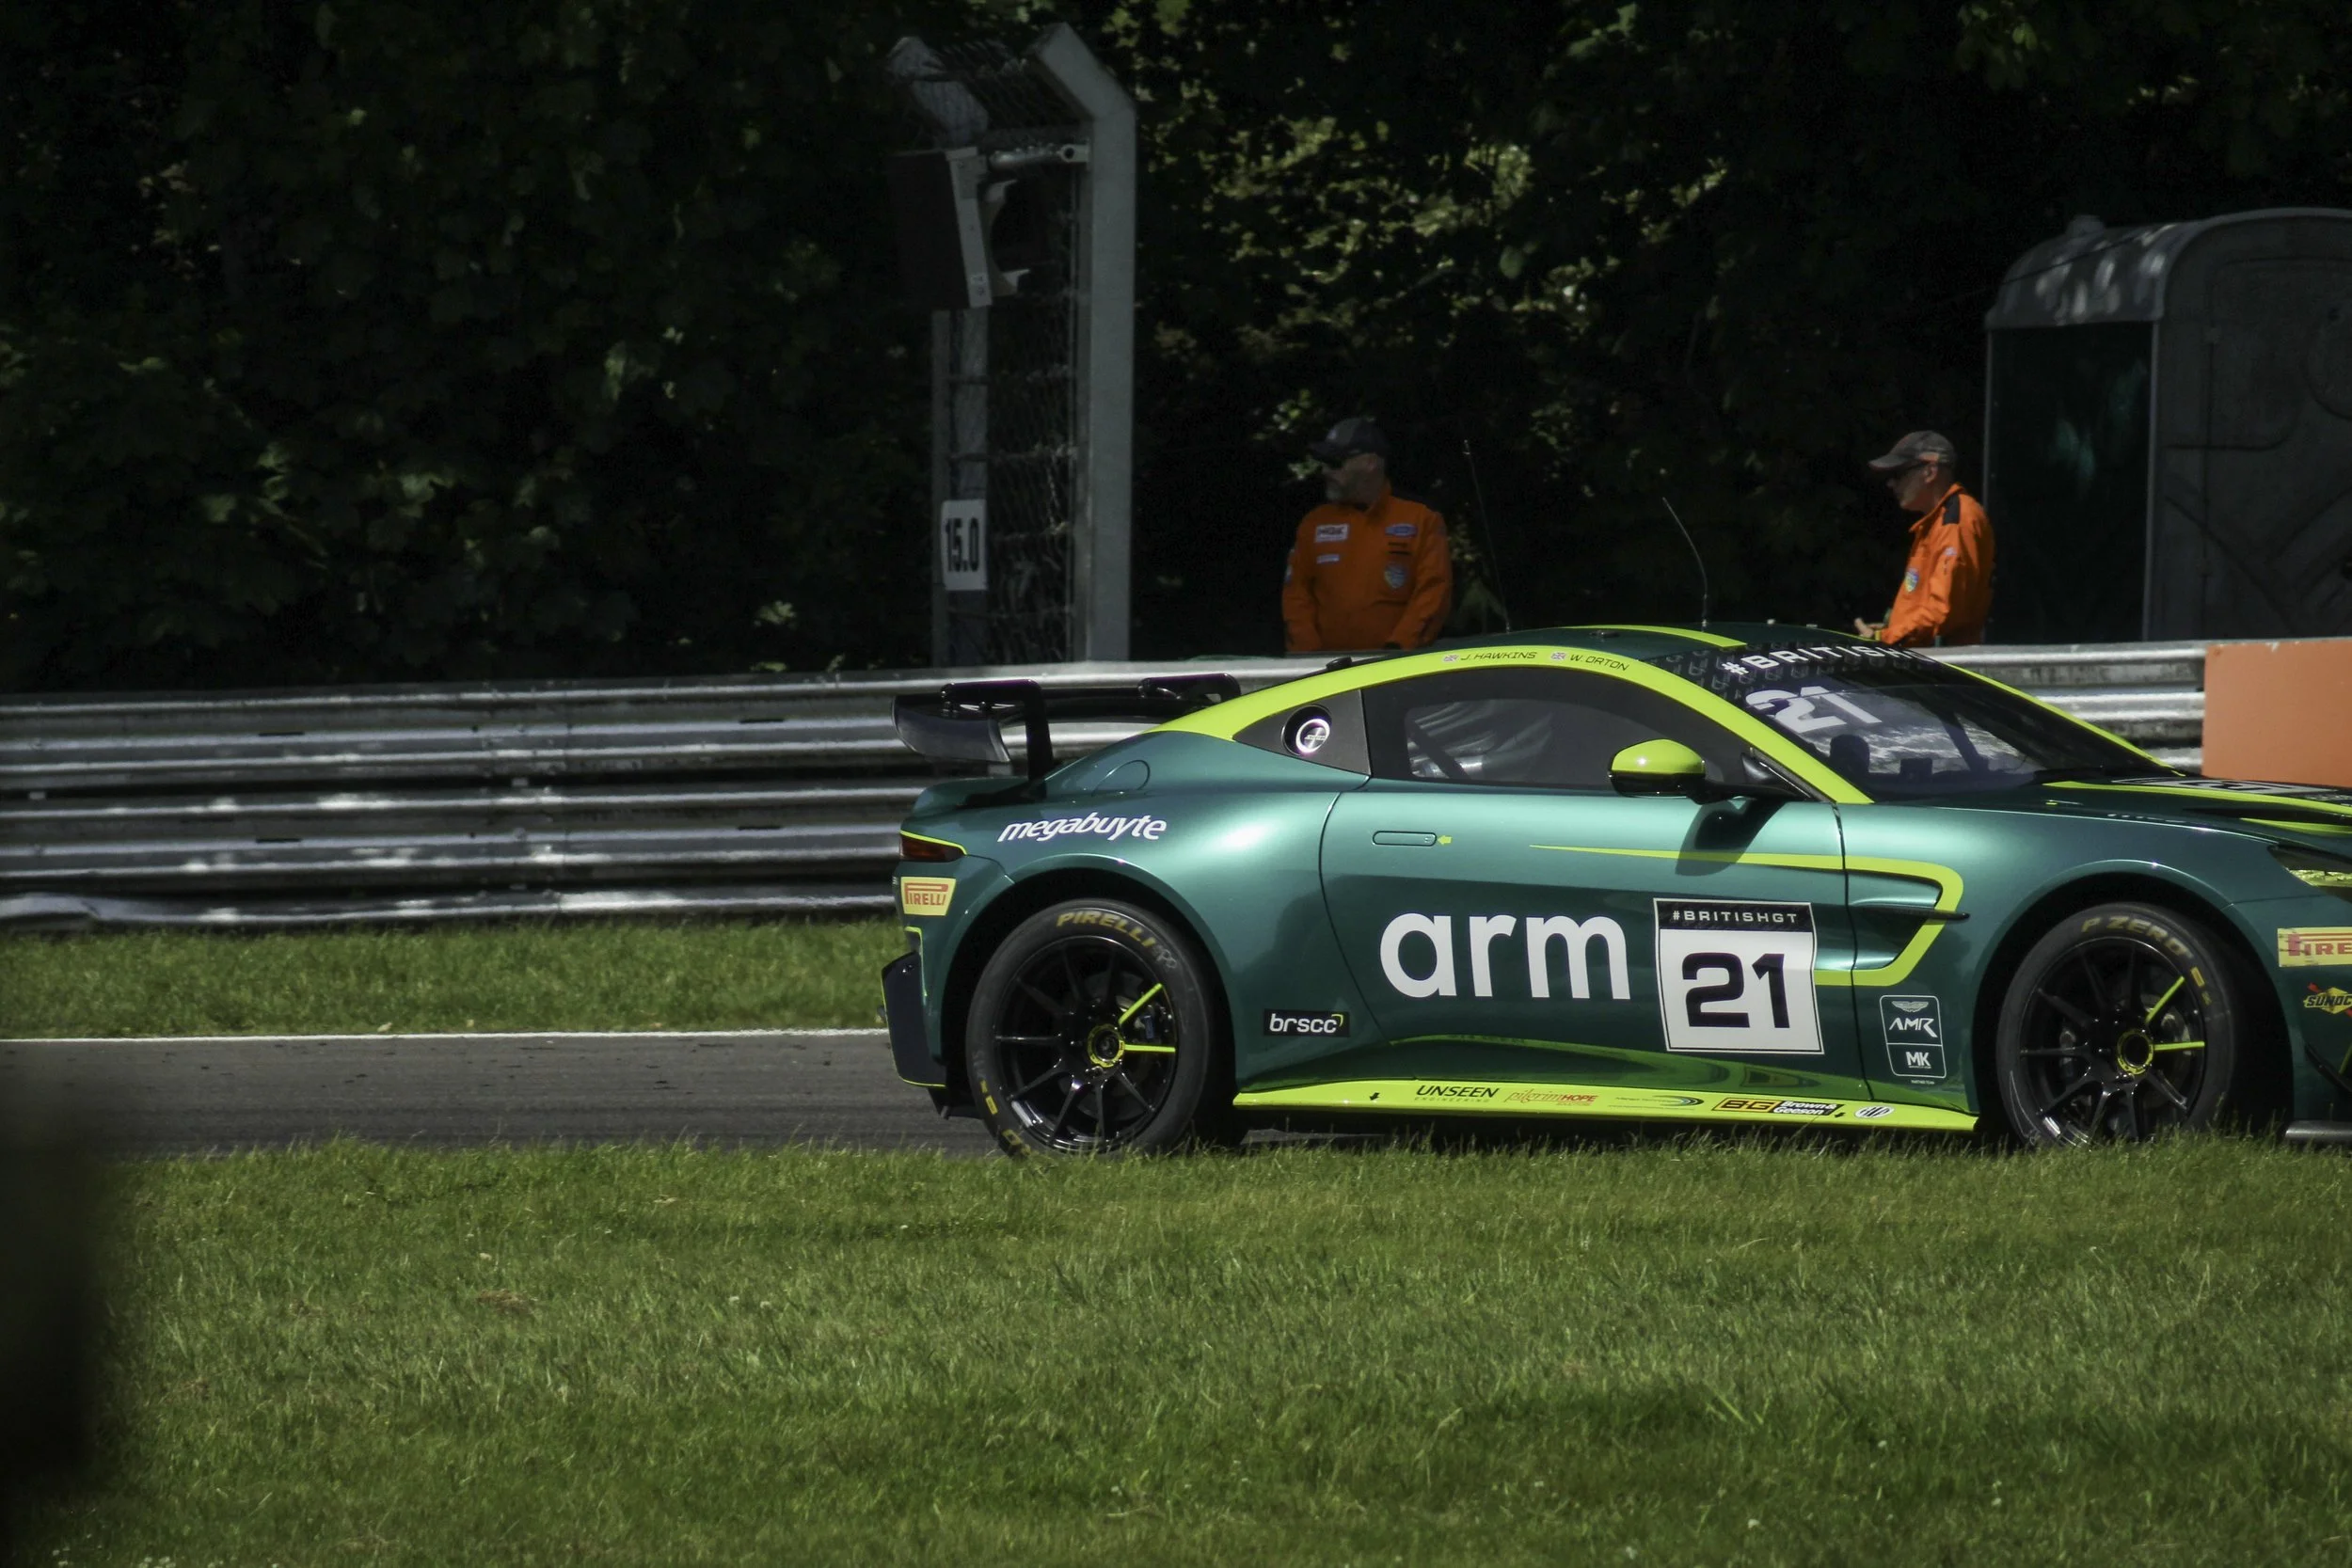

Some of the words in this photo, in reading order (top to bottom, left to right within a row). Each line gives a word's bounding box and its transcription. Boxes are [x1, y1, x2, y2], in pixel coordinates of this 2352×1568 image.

[1474, 651, 1537, 659] HAWKINS
[1585, 655, 1629, 672] ORTON
[1745, 685, 1883, 734] 21
[997, 812, 1168, 842] megabuyte
[904, 882, 949, 906] PIRELLI
[1673, 909, 1798, 925] #BRITISHGT
[1056, 909, 1156, 947] PIRELLI
[1379, 912, 1631, 1000] arm
[1682, 951, 1790, 1029] 21
[1269, 1013, 1338, 1034] brscc
[1889, 1017, 1938, 1038] AMR
[1905, 1051, 1931, 1067] MK
[1416, 1085, 1500, 1098] UNSEEN
[1772, 1106, 1823, 1115] Geeson
